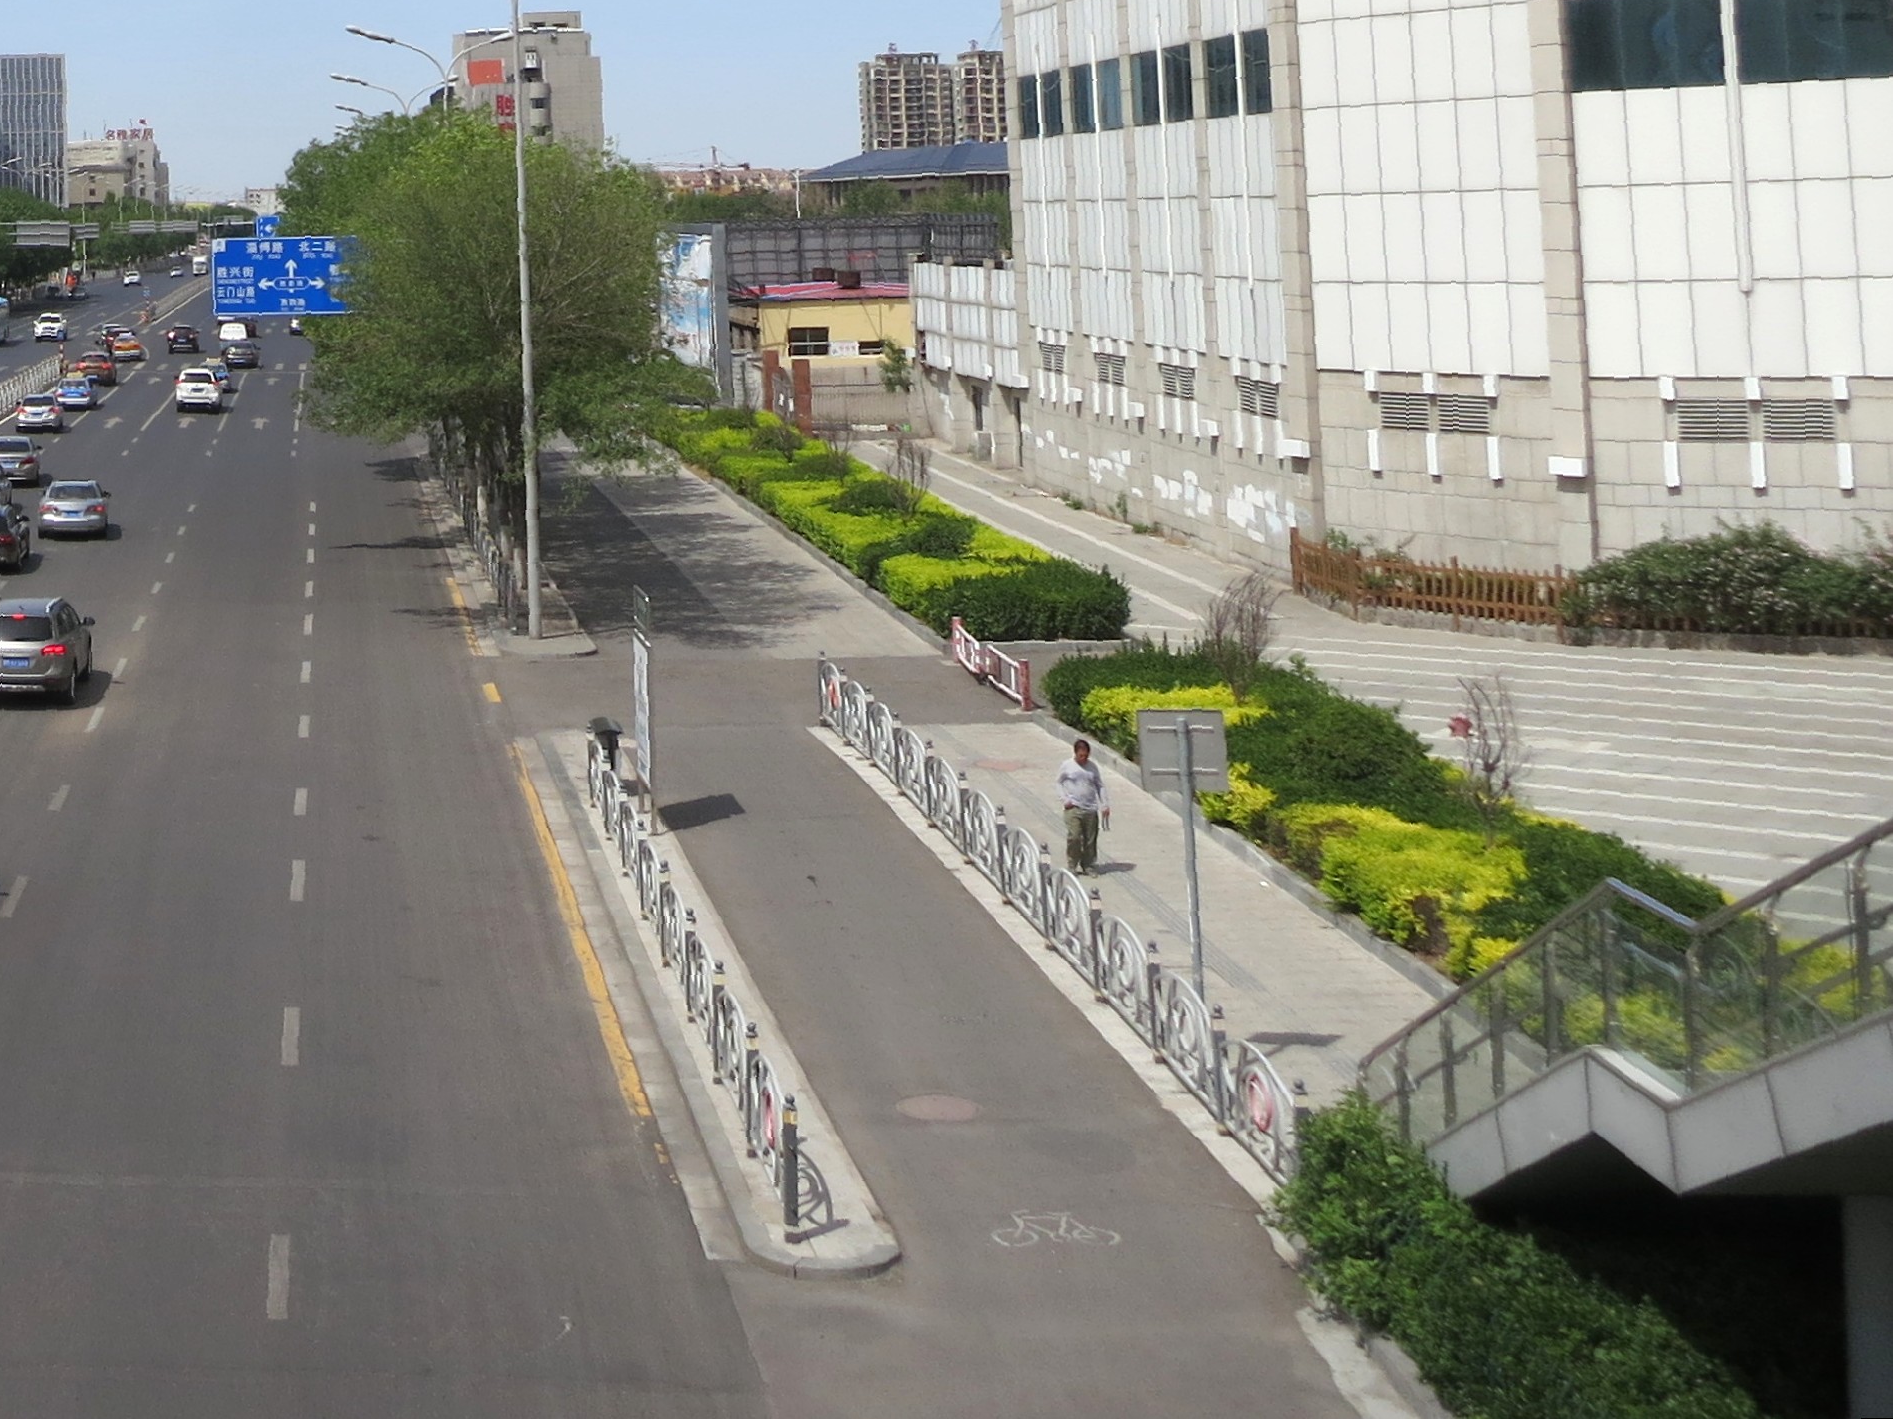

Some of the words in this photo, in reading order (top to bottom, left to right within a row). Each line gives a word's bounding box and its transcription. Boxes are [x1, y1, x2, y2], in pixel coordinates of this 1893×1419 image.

[298, 240, 337, 253] 北二路
[216, 286, 256, 298] 云门山路
